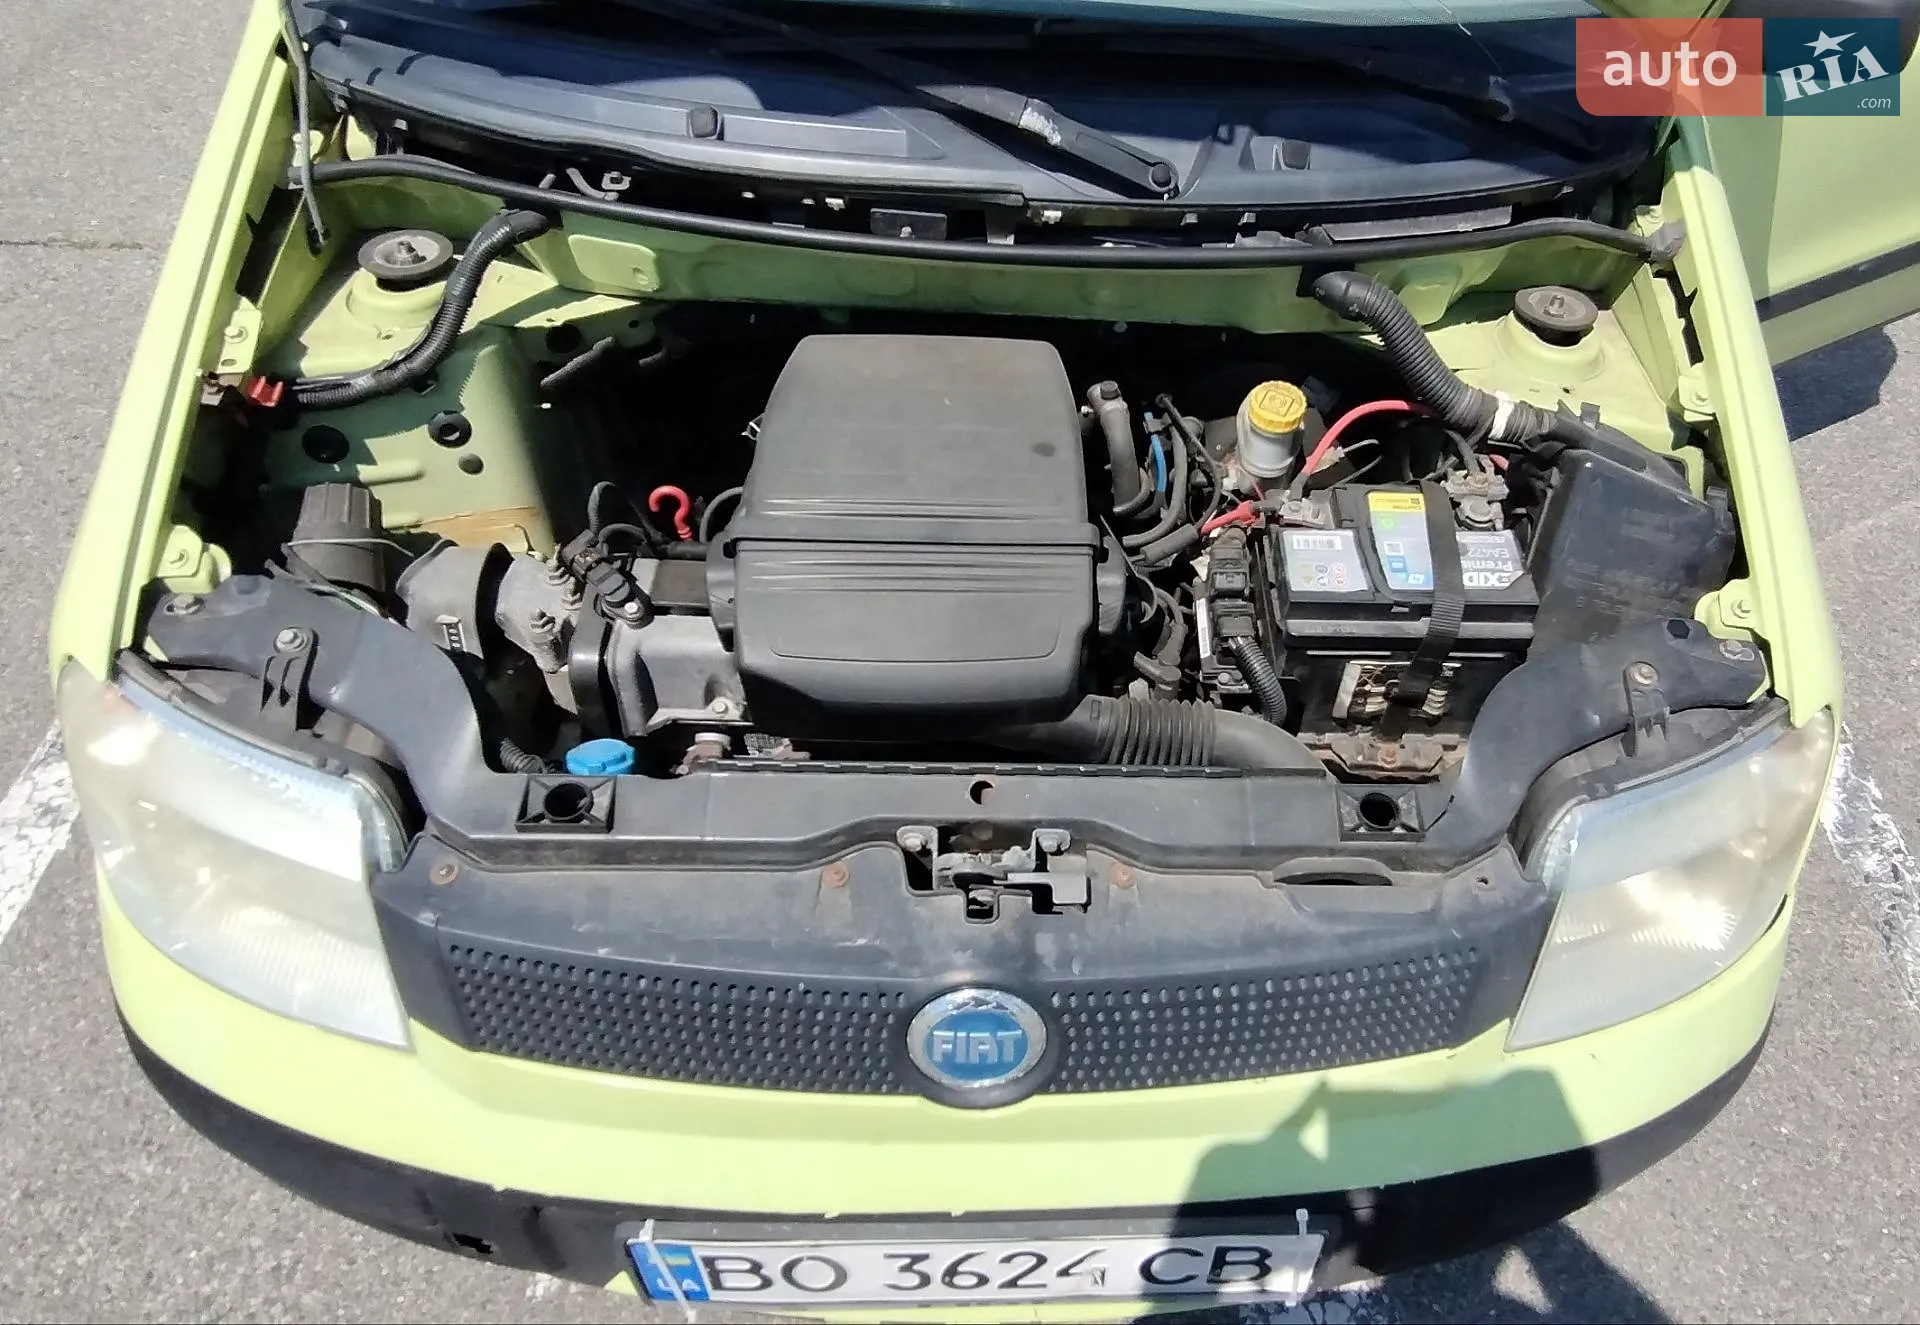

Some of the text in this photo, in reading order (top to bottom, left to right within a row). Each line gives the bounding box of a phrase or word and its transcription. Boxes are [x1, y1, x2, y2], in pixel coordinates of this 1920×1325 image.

[1463, 571, 1514, 587] EXID
[932, 1030, 1022, 1064] FIAT
[701, 1245, 1274, 1293] BO 3624 CB
